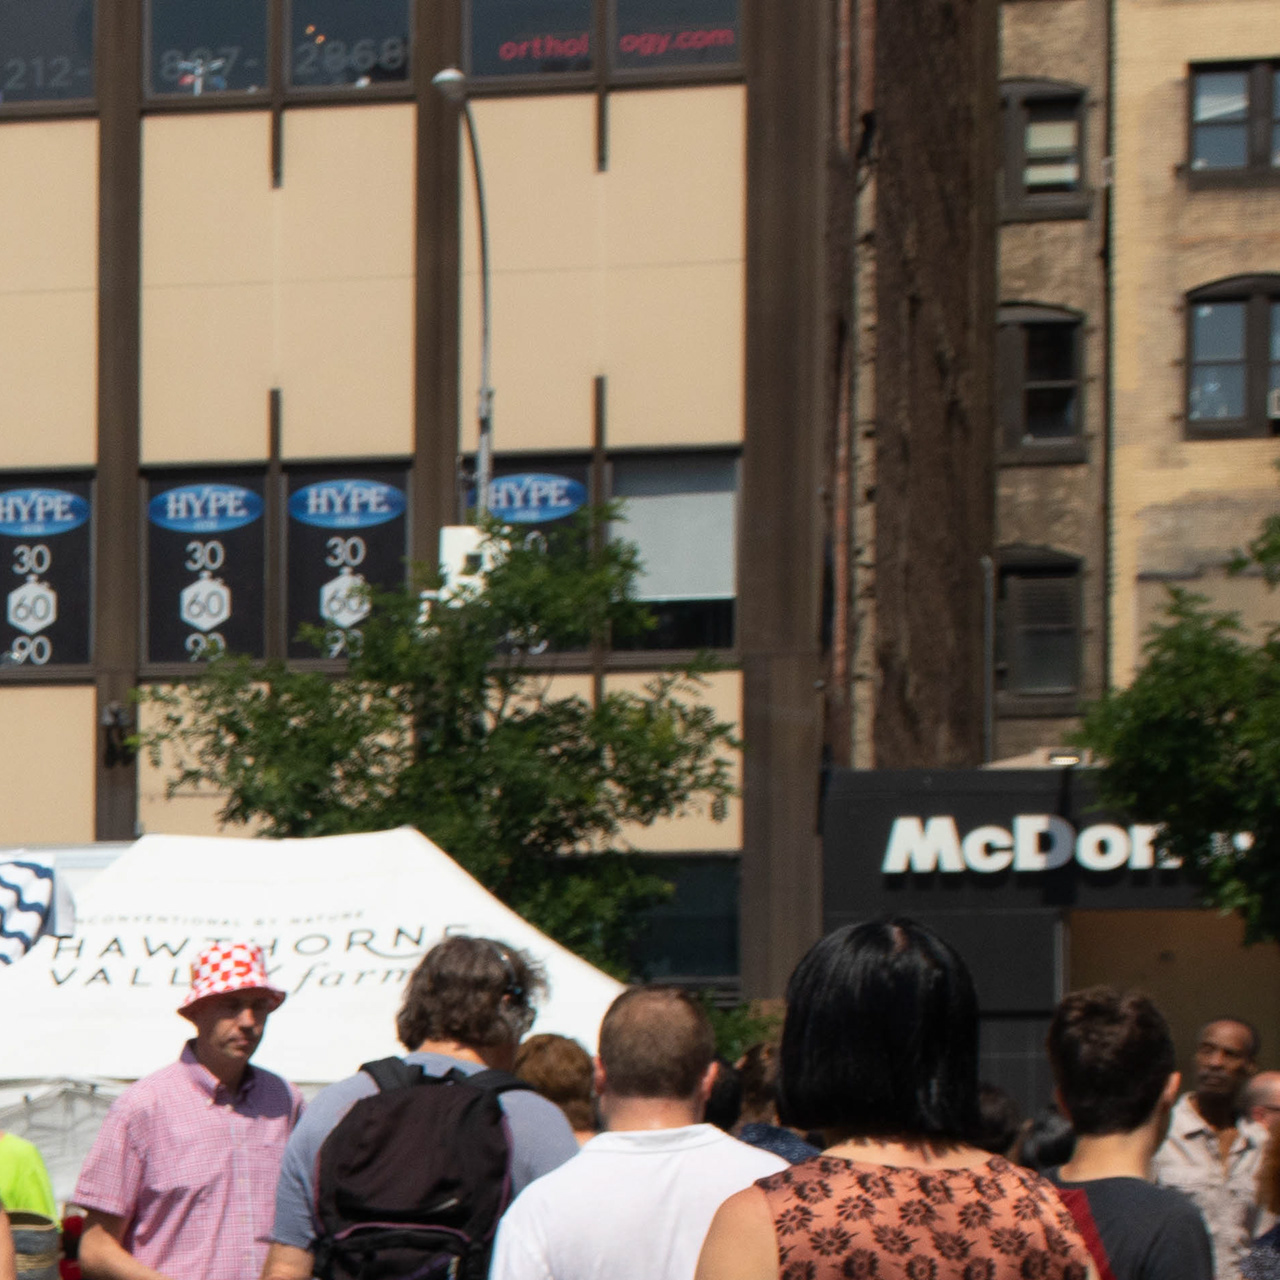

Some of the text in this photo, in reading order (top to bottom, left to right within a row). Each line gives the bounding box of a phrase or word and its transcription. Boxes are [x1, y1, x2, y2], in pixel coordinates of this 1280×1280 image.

[166, 489, 248, 520] HYPE
[306, 484, 389, 515] HYPE
[12, 543, 52, 574] 30
[185, 540, 225, 571] 30
[326, 536, 367, 567] 30
[11, 593, 52, 623] 60
[184, 588, 226, 618] 60
[11, 635, 52, 666] 90
